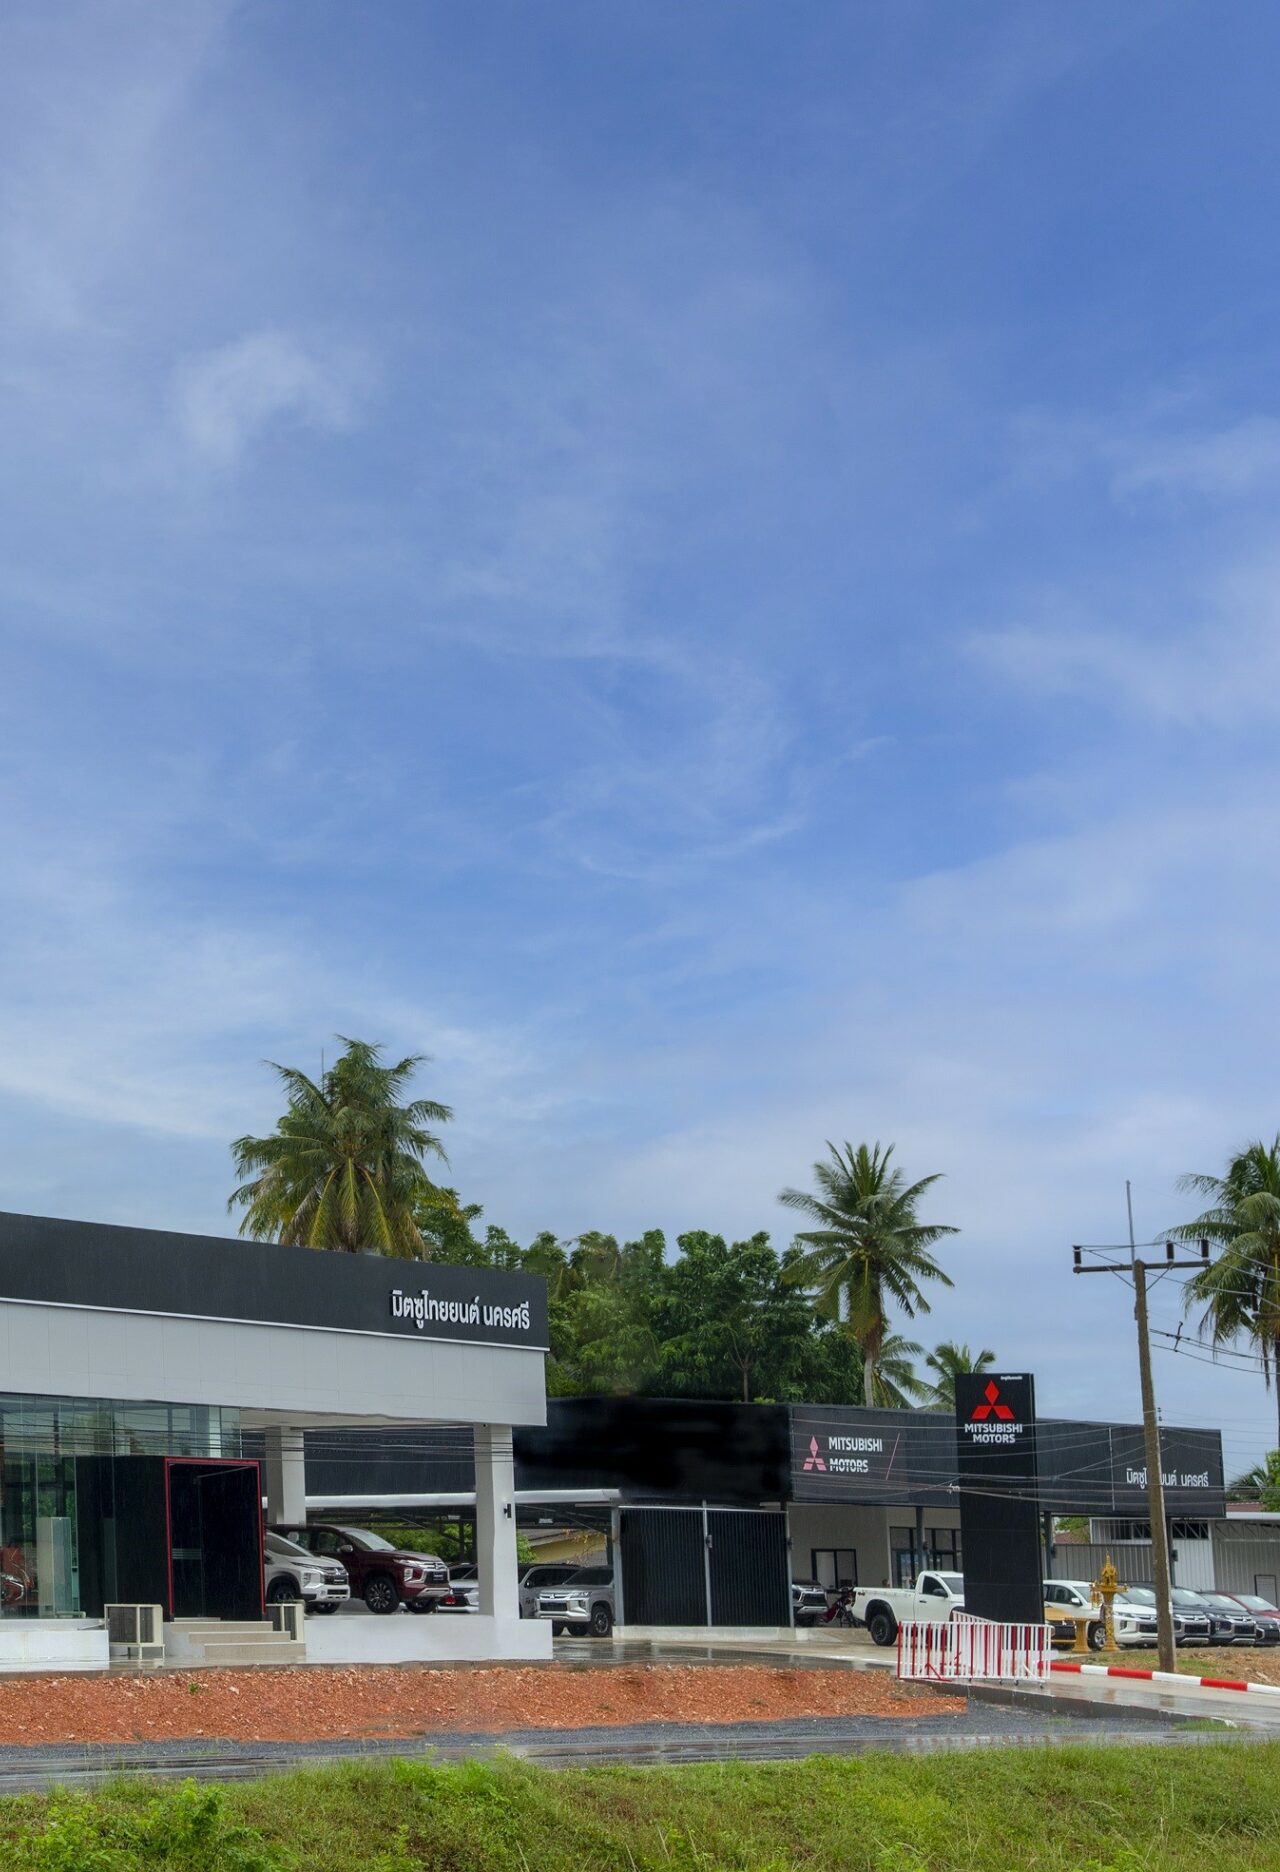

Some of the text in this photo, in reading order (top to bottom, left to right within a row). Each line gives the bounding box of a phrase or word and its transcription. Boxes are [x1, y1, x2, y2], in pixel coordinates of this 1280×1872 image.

[392, 1289, 530, 1330] มิตซูไทยยนต์ นครศรี
[964, 1423, 1023, 1433] MITSUBISHI
[828, 1436, 883, 1453] MITSUBISHI
[972, 1434, 1016, 1444] MOTORS
[829, 1458, 869, 1473] MOTORS
[1180, 1471, 1209, 1487] นครศรี
